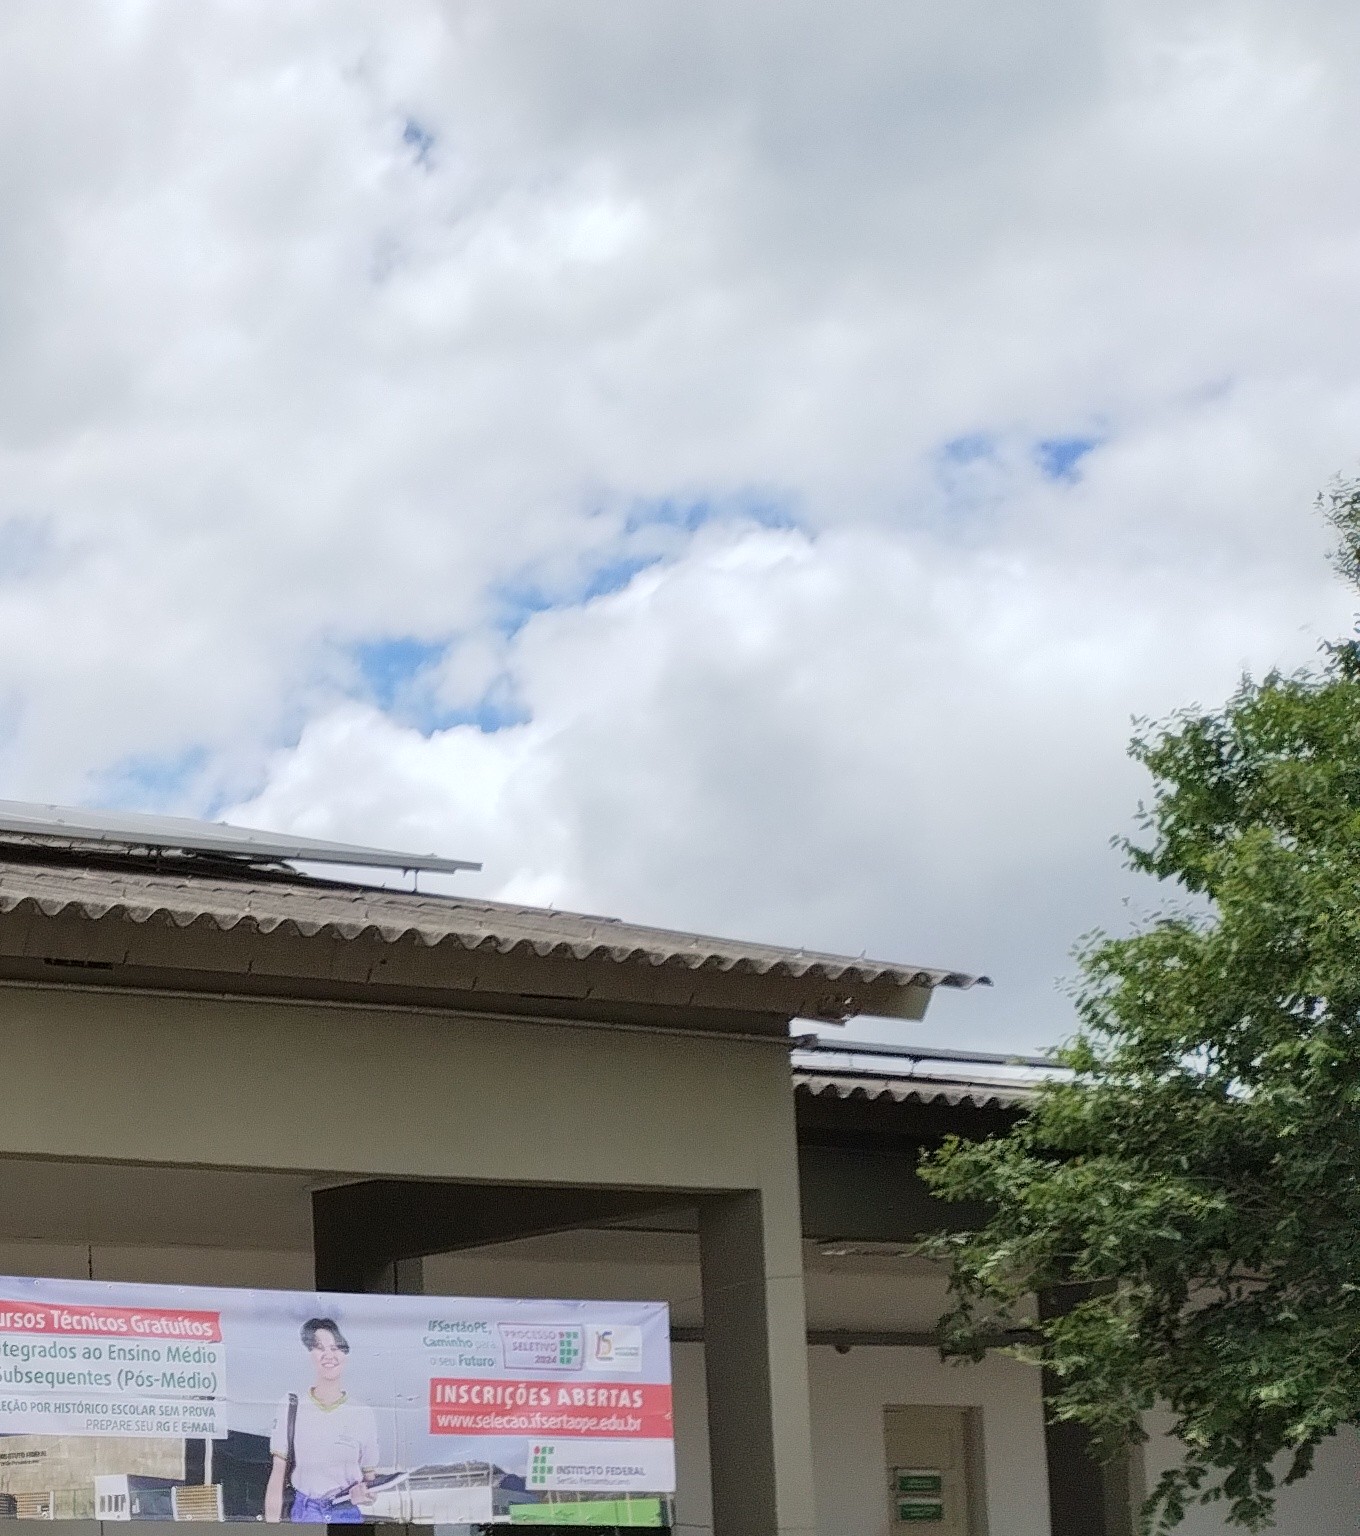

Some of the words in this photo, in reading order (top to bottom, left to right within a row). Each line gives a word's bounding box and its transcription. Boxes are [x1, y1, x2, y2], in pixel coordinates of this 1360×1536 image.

[50, 1309, 128, 1332] Técnicos
[131, 1315, 214, 1337] Gratuitos
[422, 1336, 474, 1349] Caminho
[512, 1341, 558, 1352] SELETIVO
[83, 1348, 103, 1361] ao
[108, 1344, 161, 1363] Ensino
[166, 1345, 217, 1364] Médio
[458, 1354, 495, 1368] Futuro
[534, 1355, 558, 1365] 2024
[117, 1369, 218, 1392] (Pós-Médio)
[435, 1383, 551, 1410] INSCRIÇÕES
[556, 1388, 644, 1409] ABERTAS
[30, 1402, 52, 1414] POR
[53, 1401, 109, 1415] HISTÓRICO
[111, 1404, 156, 1416] ESCOLAR
[159, 1405, 180, 1417] SEM
[182, 1406, 216, 1418] PROVA
[85, 1419, 133, 1432] PREPARE
[134, 1420, 154, 1433] SEU
[156, 1420, 172, 1433] RG
[173, 1421, 179, 1433] E
[181, 1421, 217, 1434] E-MAIL
[436, 1412, 642, 1434] www.selecao.ifsertaope.edu.br
[556, 1465, 605, 1476] INSTITUTO
[605, 1466, 646, 1477] FEDERAL
